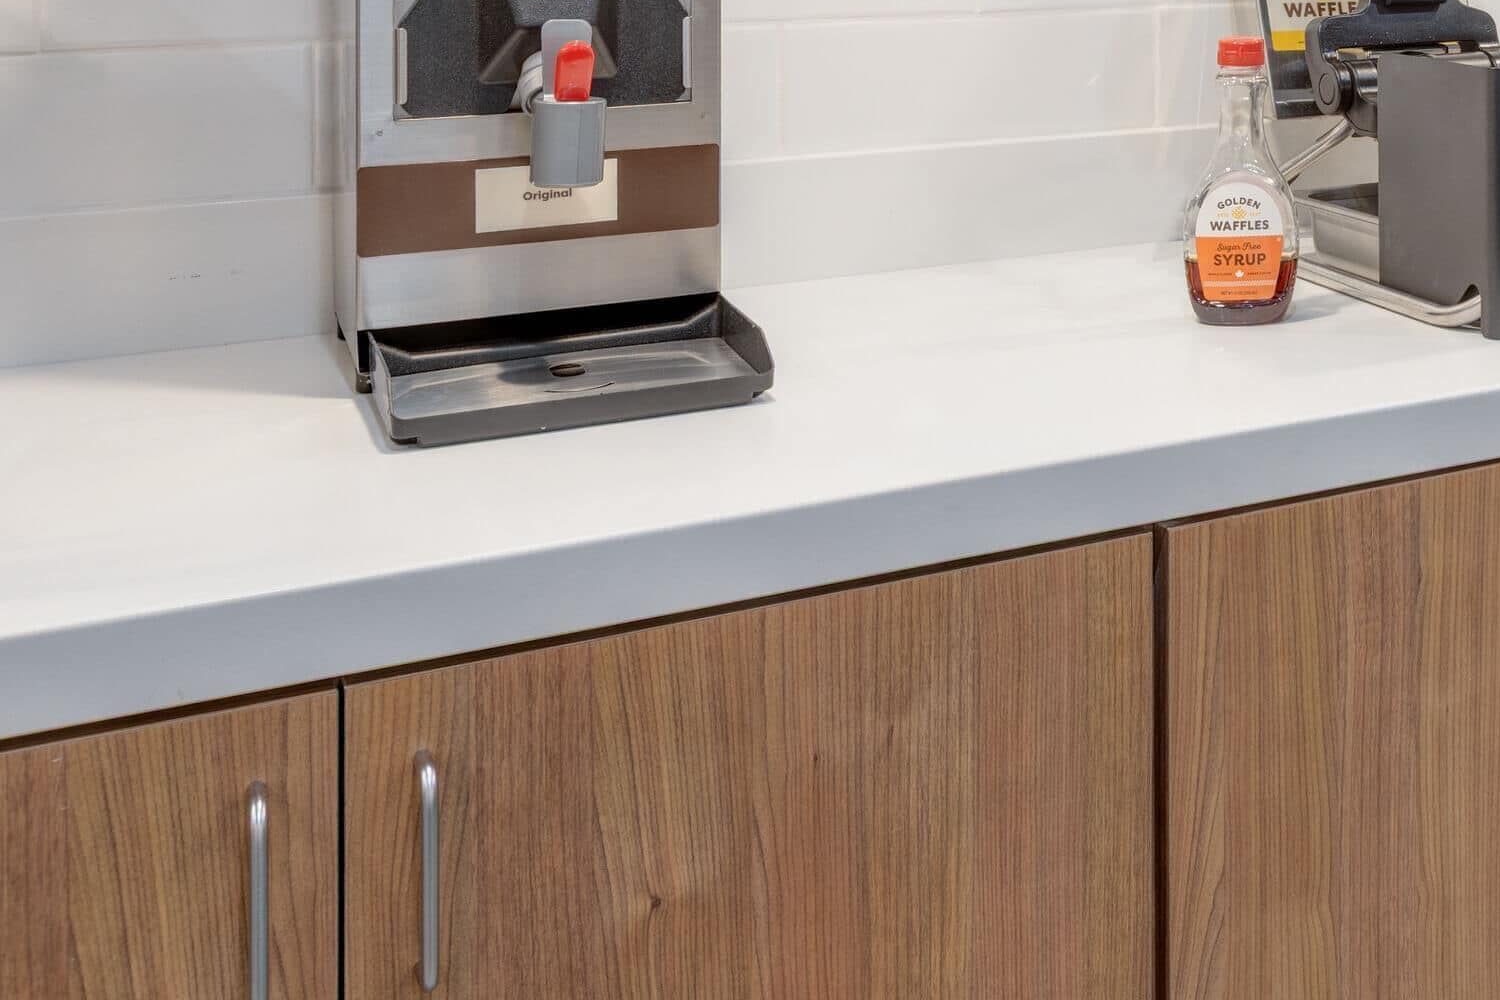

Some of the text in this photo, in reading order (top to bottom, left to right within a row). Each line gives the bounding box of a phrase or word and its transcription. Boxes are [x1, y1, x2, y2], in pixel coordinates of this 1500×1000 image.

[1283, 1, 1358, 18] WAFFLE
[523, 188, 573, 201] Original
[1217, 197, 1261, 209] GOLDEN
[1210, 219, 1269, 231] WAFFLES
[1217, 241, 1262, 253] Sugar Free
[1213, 253, 1266, 266] SYRUP
